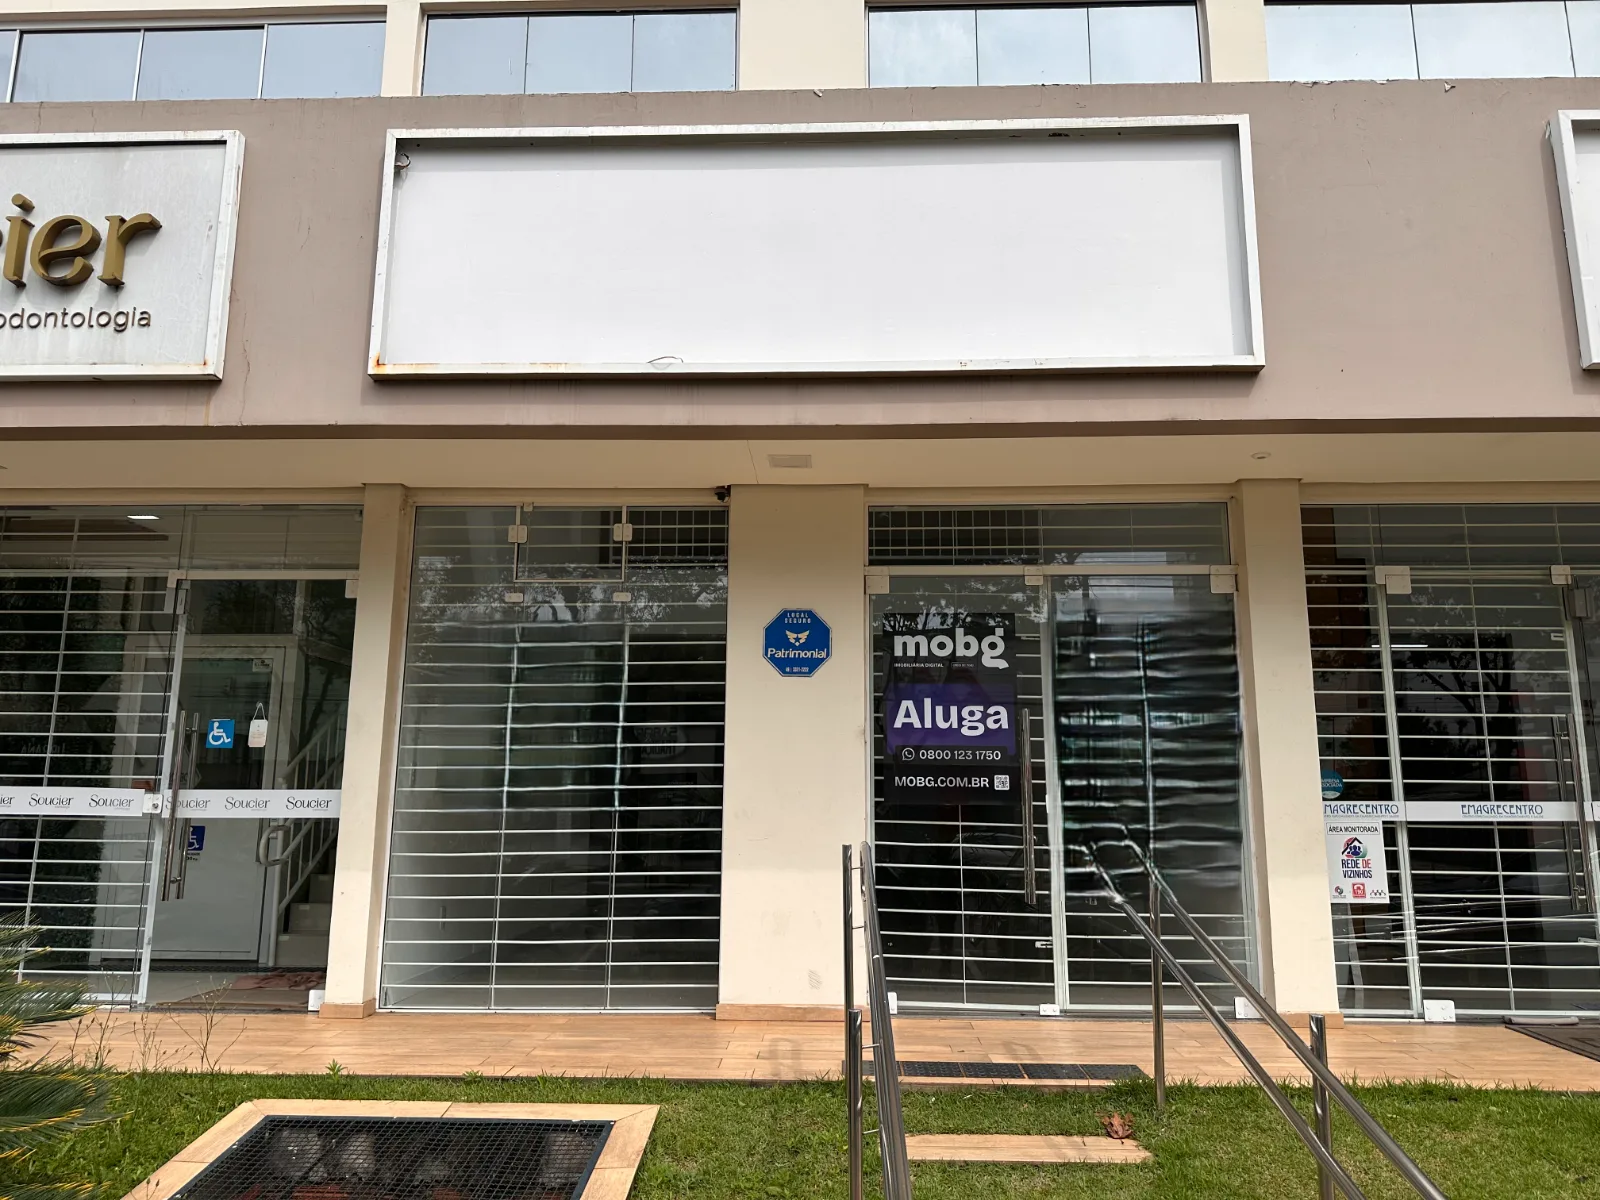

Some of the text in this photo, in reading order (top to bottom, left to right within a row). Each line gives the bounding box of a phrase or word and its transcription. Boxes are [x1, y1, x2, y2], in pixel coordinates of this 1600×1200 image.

[0, 193, 163, 288] ier
[767, 647, 827, 658] Patrimonial
[893, 697, 1009, 737] Aluga
[919, 749, 1001, 760] 0800 123 1750
[894, 776, 990, 788] MOBG.COM.BR
[0, 794, 15, 806] ier
[28, 792, 75, 807] Soucier
[88, 793, 135, 808] Soucier
[224, 795, 271, 810] Soucier
[285, 795, 333, 810] Soucier
[1322, 804, 1399, 814] MAGRECENTRO
[1461, 804, 1544, 814] EMAGRECENTRO
[1341, 859, 1371, 868] REDE DE
[1342, 870, 1372, 878] VIZINHOS
